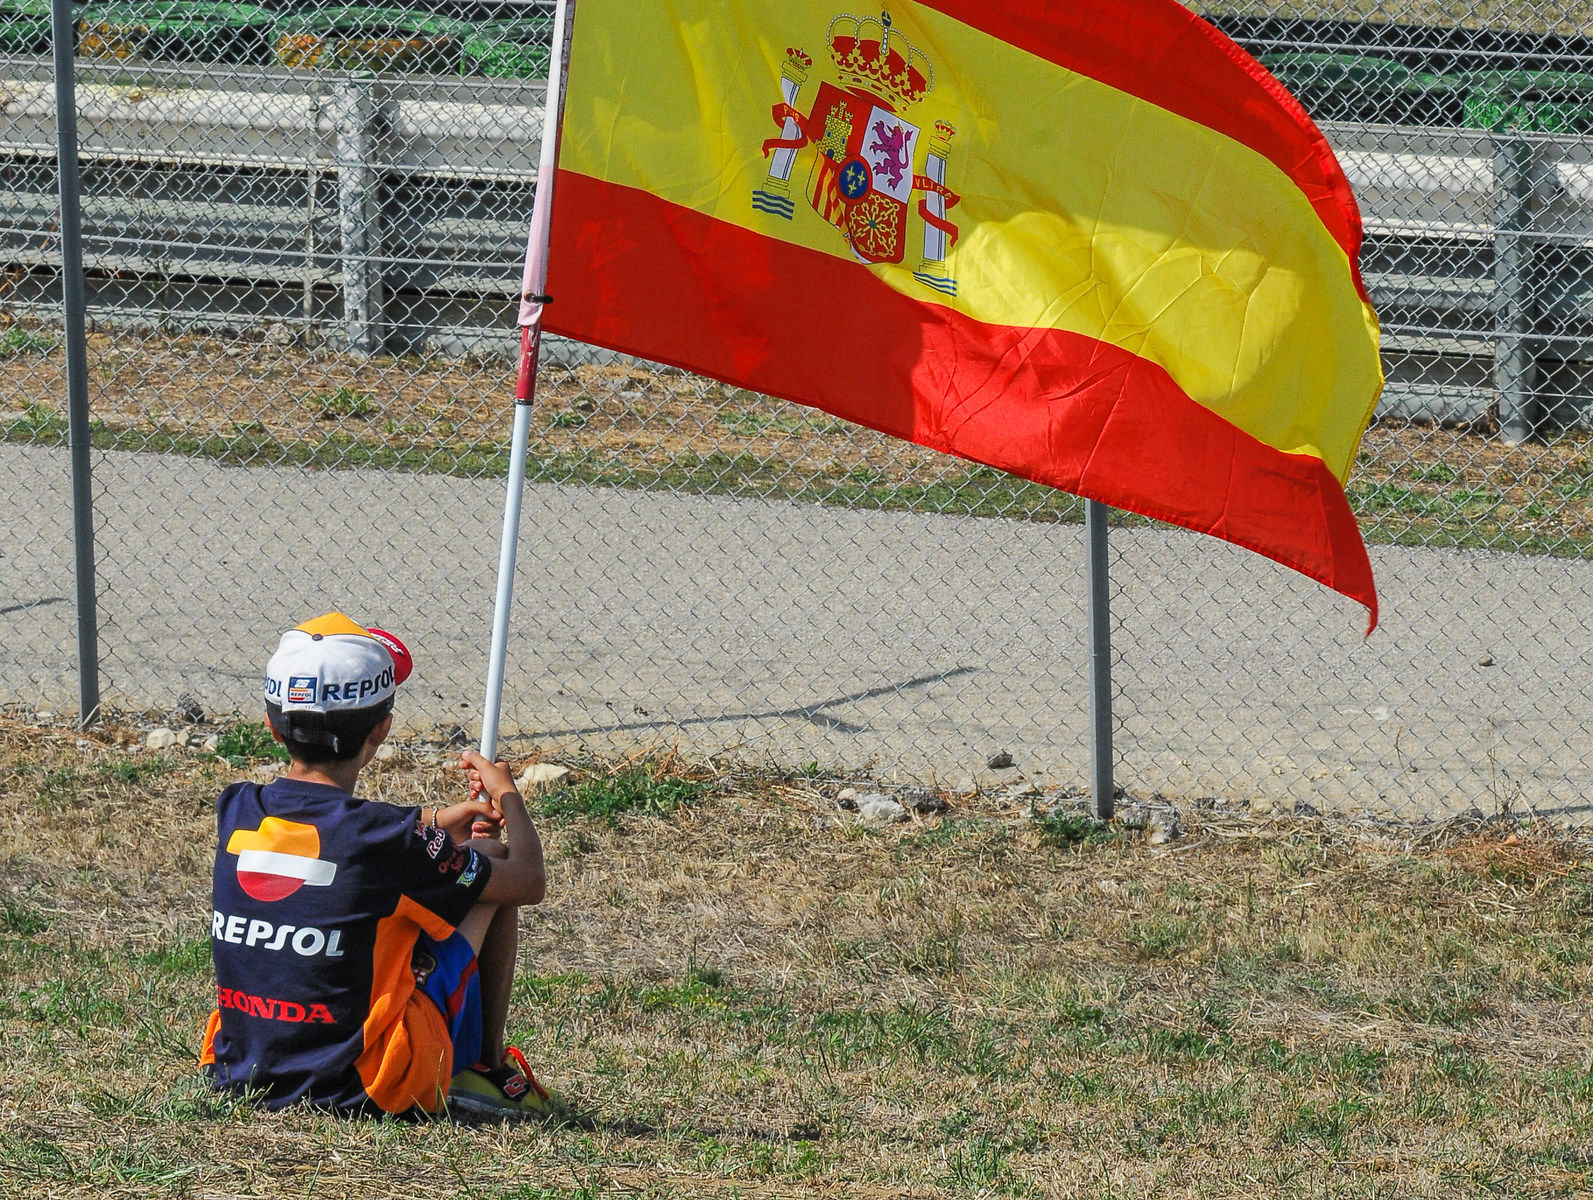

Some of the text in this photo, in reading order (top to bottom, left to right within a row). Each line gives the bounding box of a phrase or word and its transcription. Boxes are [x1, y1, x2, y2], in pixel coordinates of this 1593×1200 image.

[321, 665, 395, 701] REPSOL
[211, 910, 344, 956] REPSOL
[217, 985, 338, 1024] HONDA
